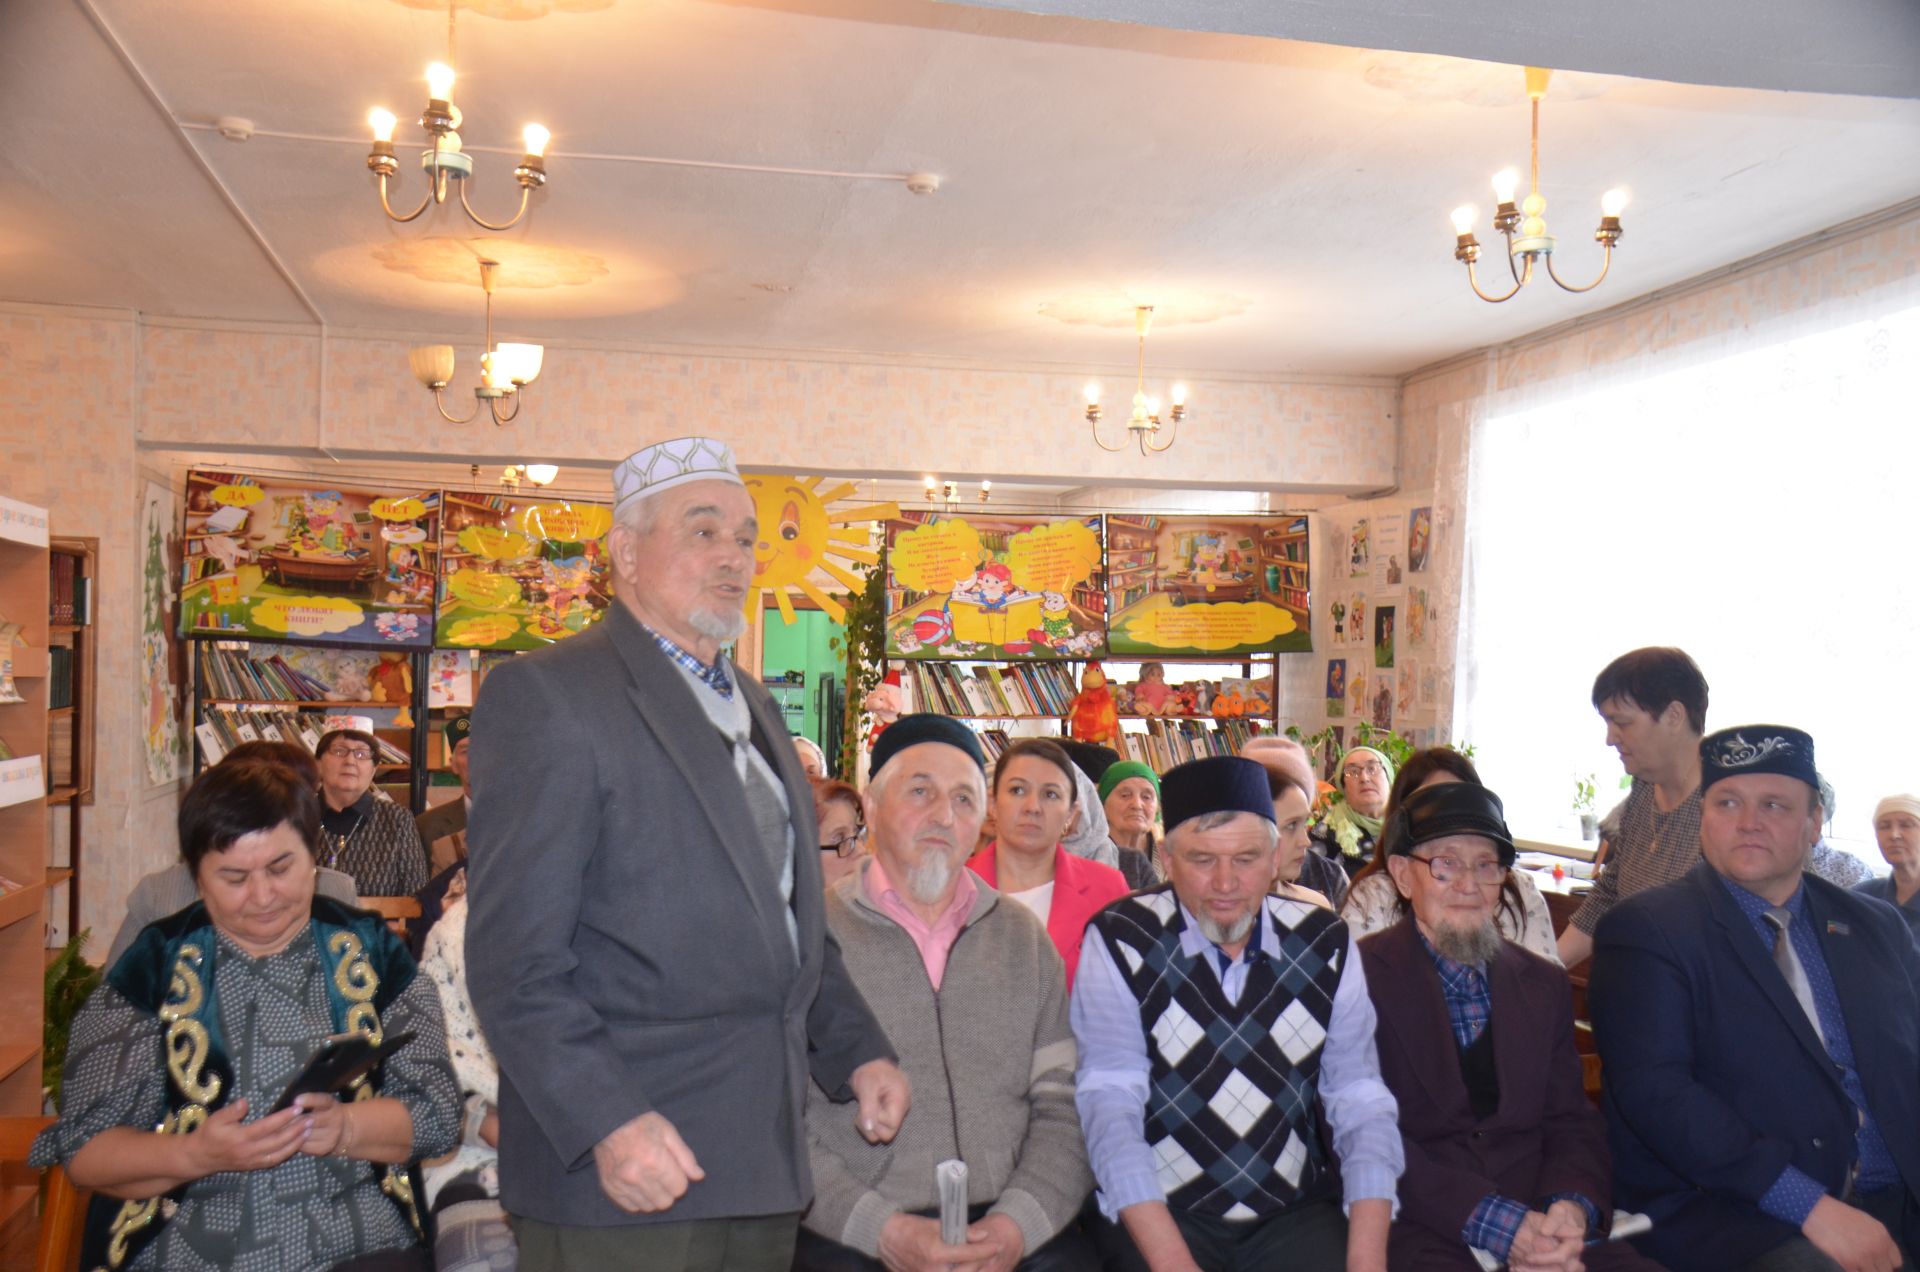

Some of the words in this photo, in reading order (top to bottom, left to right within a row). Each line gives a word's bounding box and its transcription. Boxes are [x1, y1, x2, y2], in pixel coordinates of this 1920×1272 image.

[225, 489, 247, 502] ДА
[382, 503, 410, 515] НЕТ
[242, 732, 252, 740] Б
